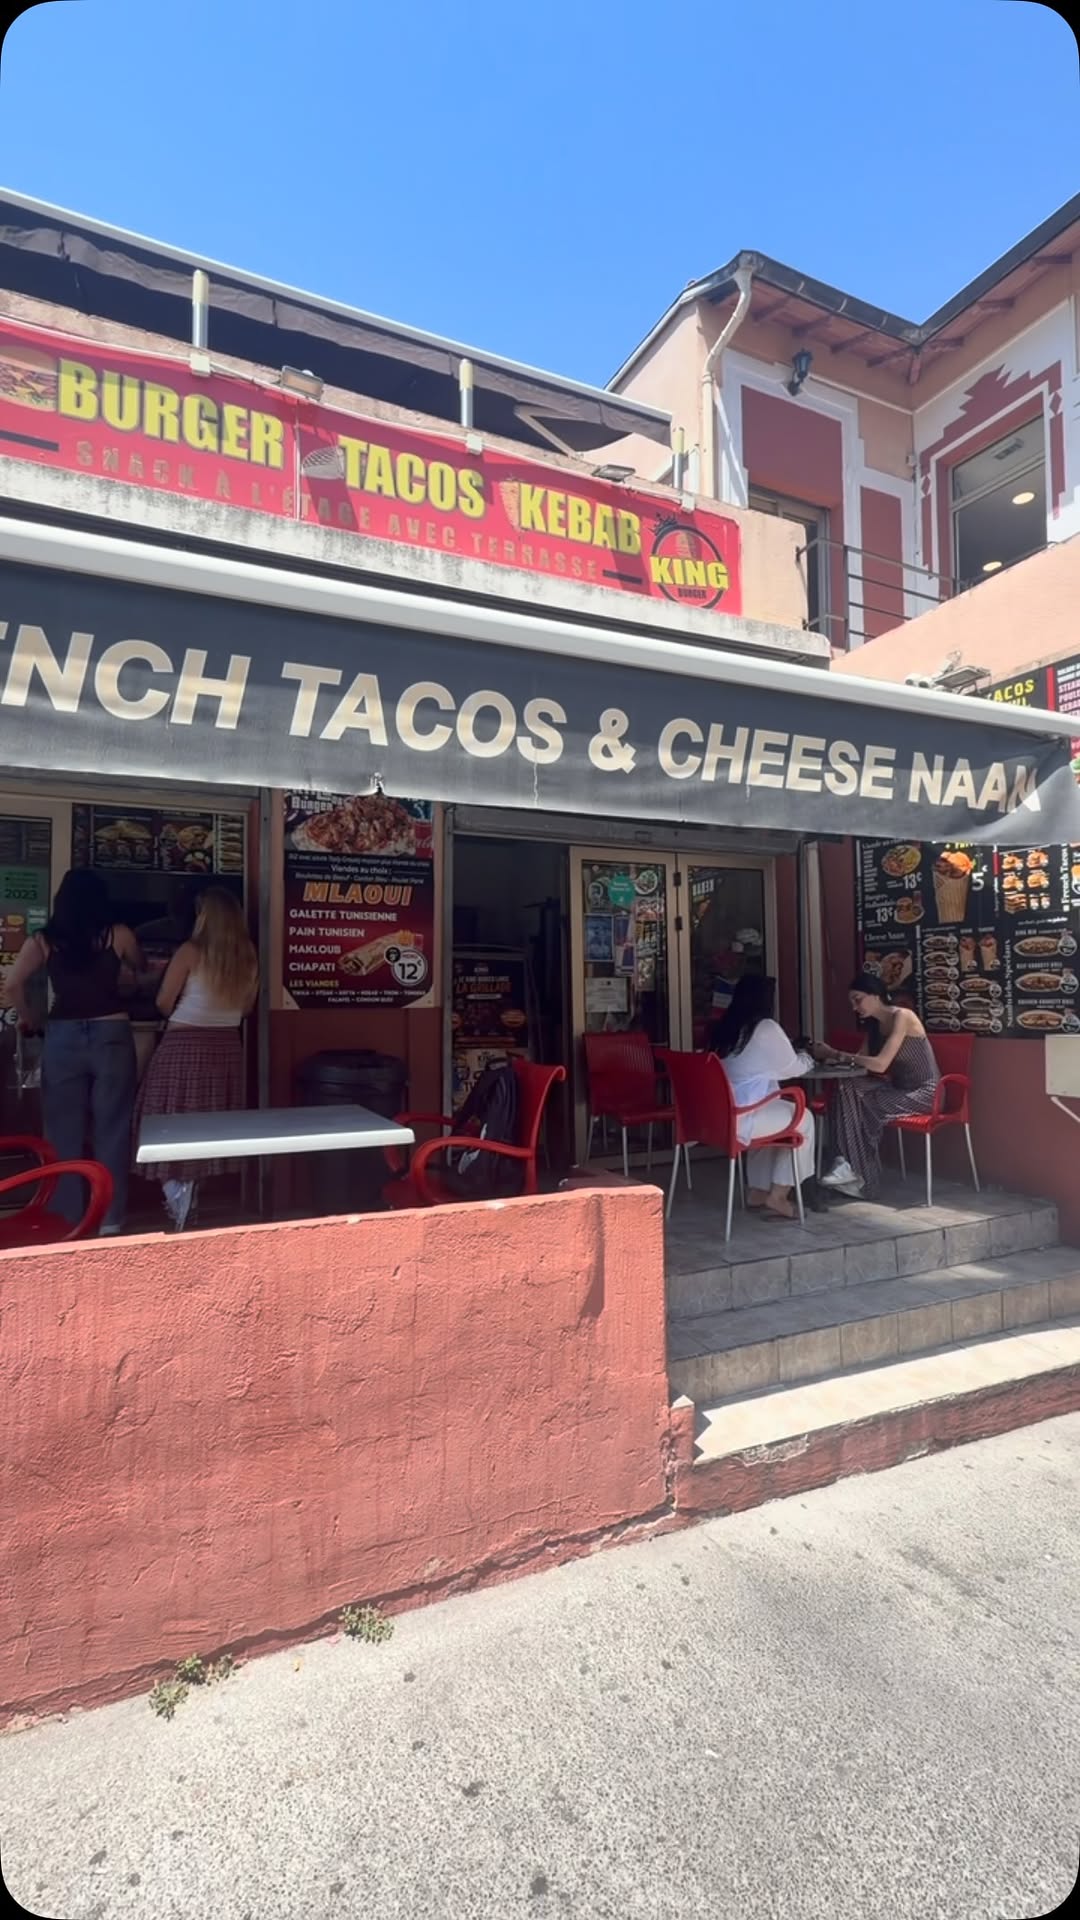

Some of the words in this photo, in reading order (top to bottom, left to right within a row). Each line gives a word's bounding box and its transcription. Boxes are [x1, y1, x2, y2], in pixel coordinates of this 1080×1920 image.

[59, 359, 284, 469] BURGER
[339, 435, 485, 518] TACOS
[519, 483, 641, 555] KEBAB
[76, 441, 196, 491] SNACK
[388, 514, 456, 547] AVEC
[472, 532, 598, 579] TERRASSE
[649, 556, 729, 590] KING
[987, 679, 1035, 702] ACOS
[281, 662, 567, 764] TACOS
[588, 708, 636, 774] &
[657, 717, 896, 799] CHEESE
[5, 889, 37, 900] 2023
[303, 881, 413, 906] MLAOUI
[289, 909, 337, 920] GALETTE
[339, 910, 398, 922] TUNISIENNE
[289, 927, 316, 937] PAIN
[318, 927, 365, 938] TUNISIEN
[289, 944, 342, 955] MAKLOUB
[289, 962, 336, 973] CHAPATI
